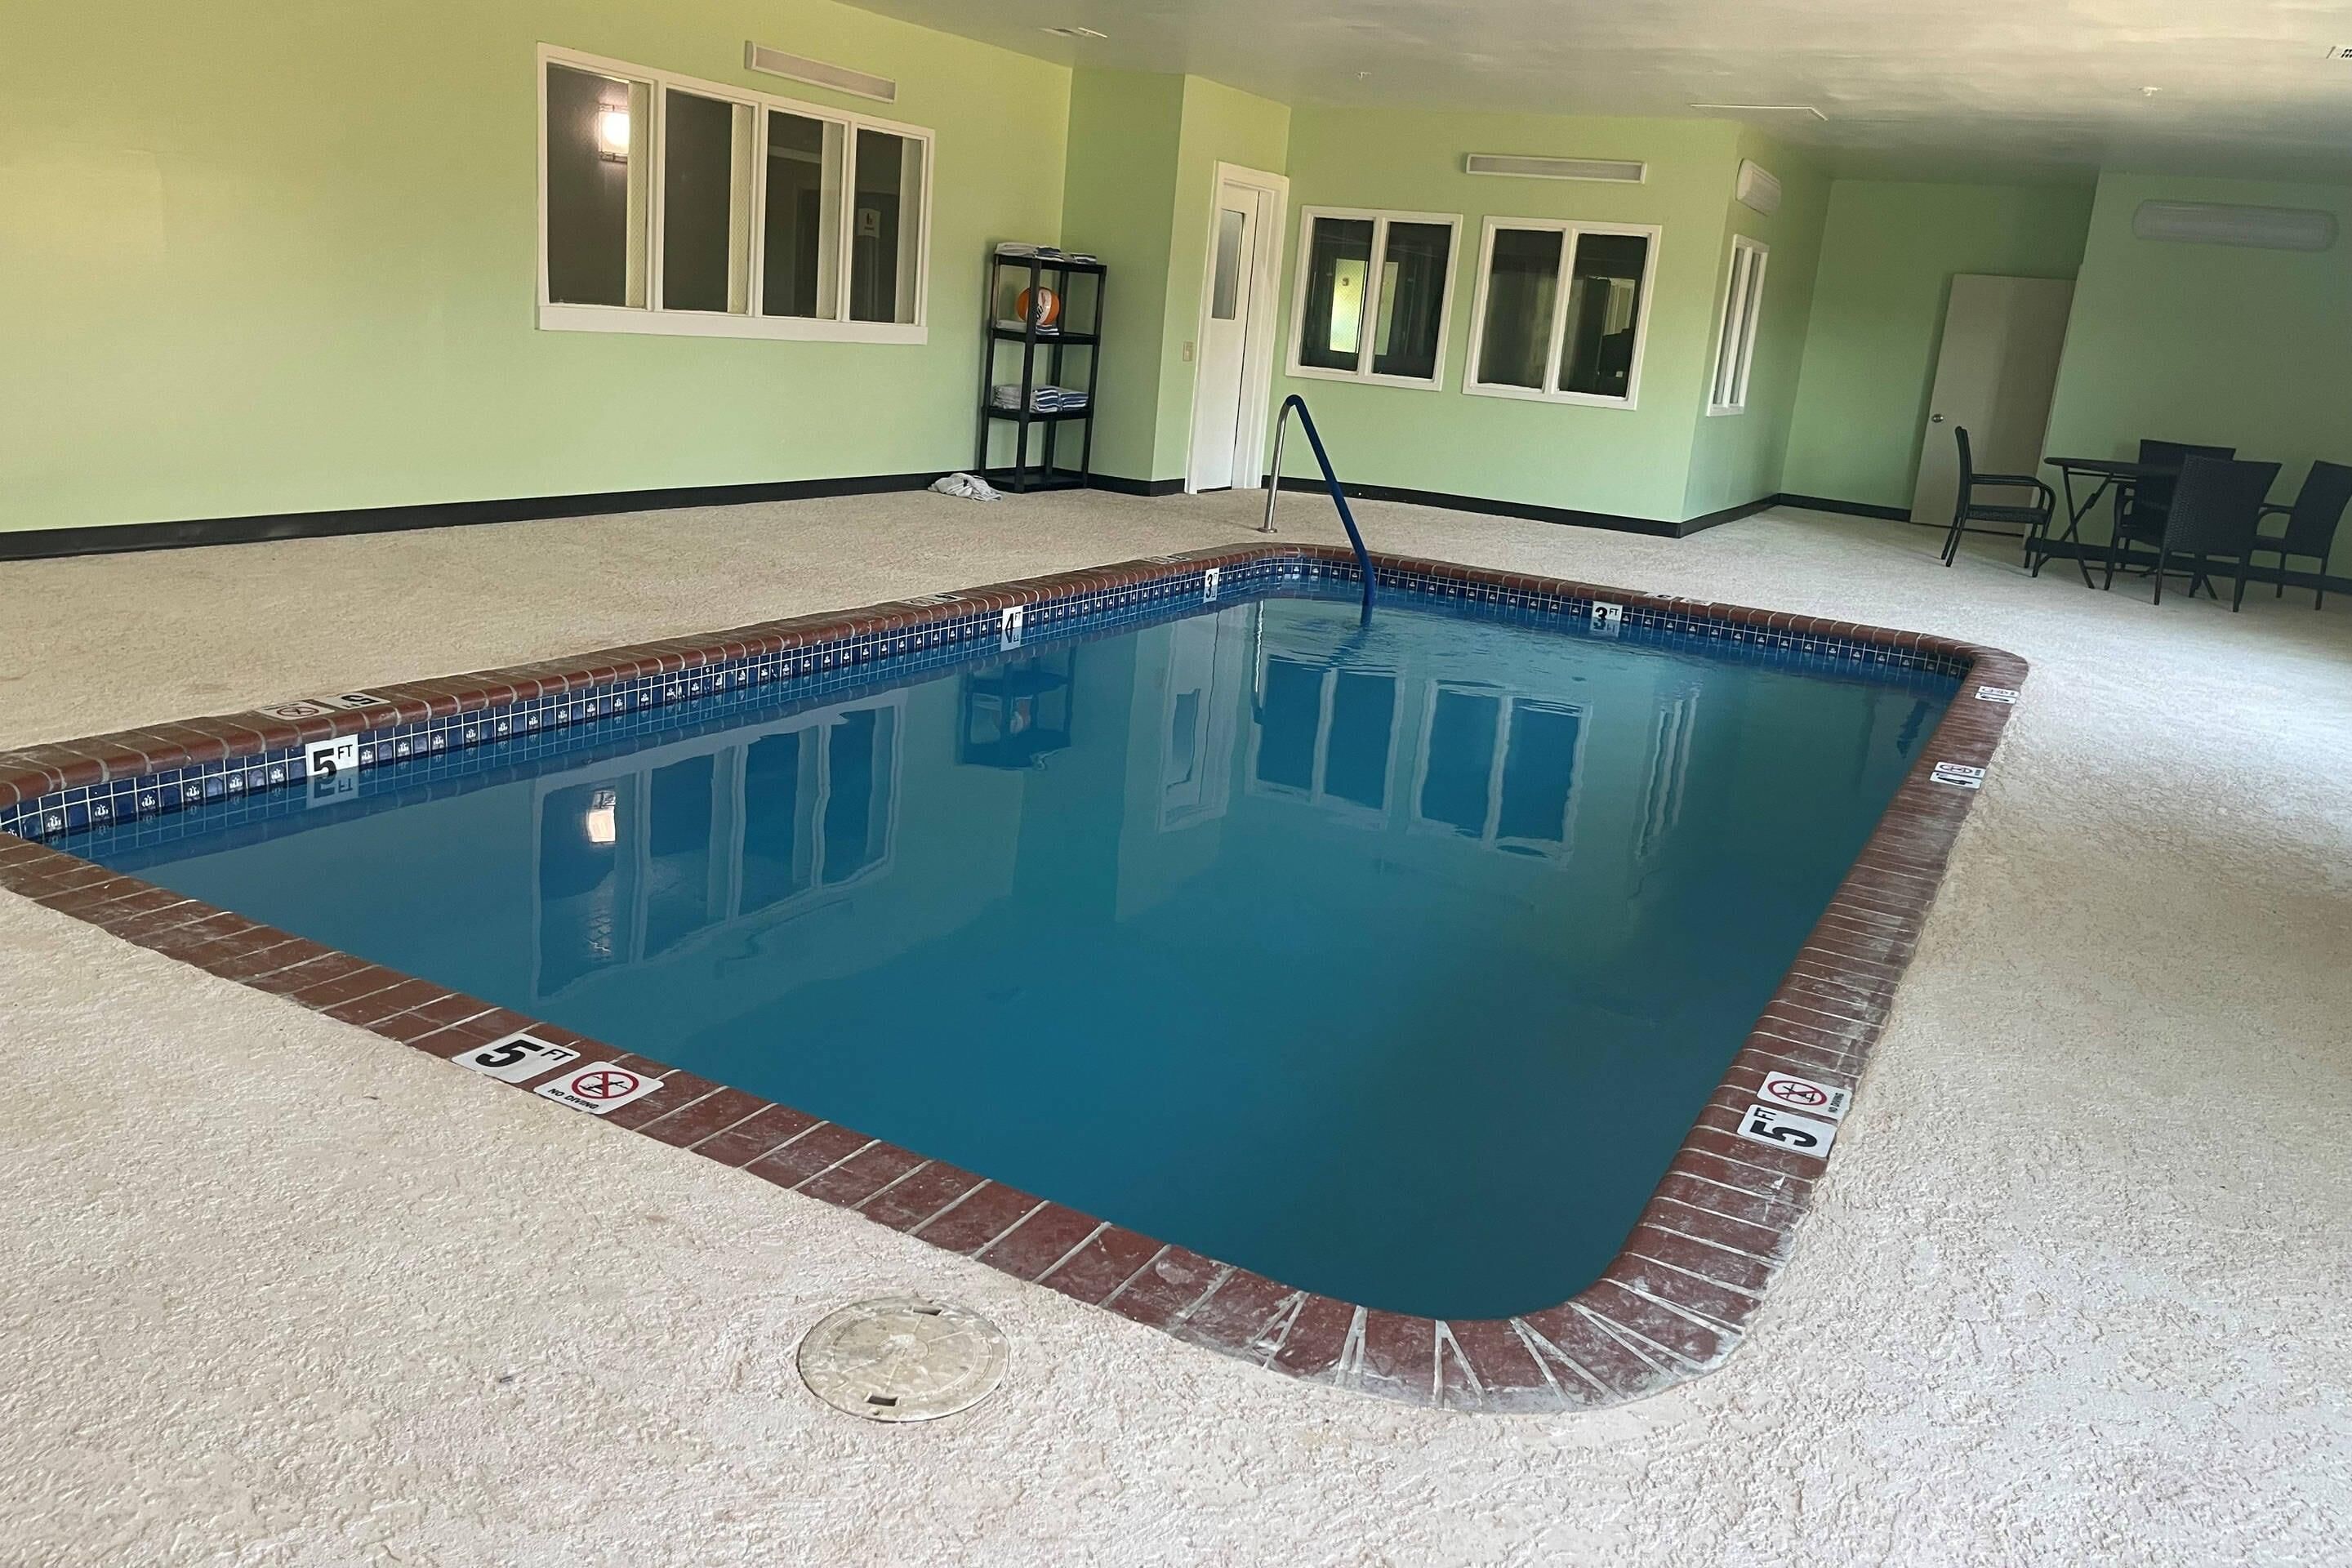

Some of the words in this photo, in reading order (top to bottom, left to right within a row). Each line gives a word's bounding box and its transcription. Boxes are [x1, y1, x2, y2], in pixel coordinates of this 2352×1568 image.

[1005, 613, 1014, 630] 4
[1595, 607, 1608, 620] 3
[1609, 608, 1619, 616] FT
[314, 747, 336, 776] 5
[338, 744, 353, 760] FT
[475, 1039, 545, 1067] 5
[540, 1049, 573, 1061] FT
[547, 1089, 565, 1097] NO
[564, 1095, 599, 1110] DIVING
[1753, 1107, 1776, 1121] FT
[1749, 1120, 1818, 1147] 5
